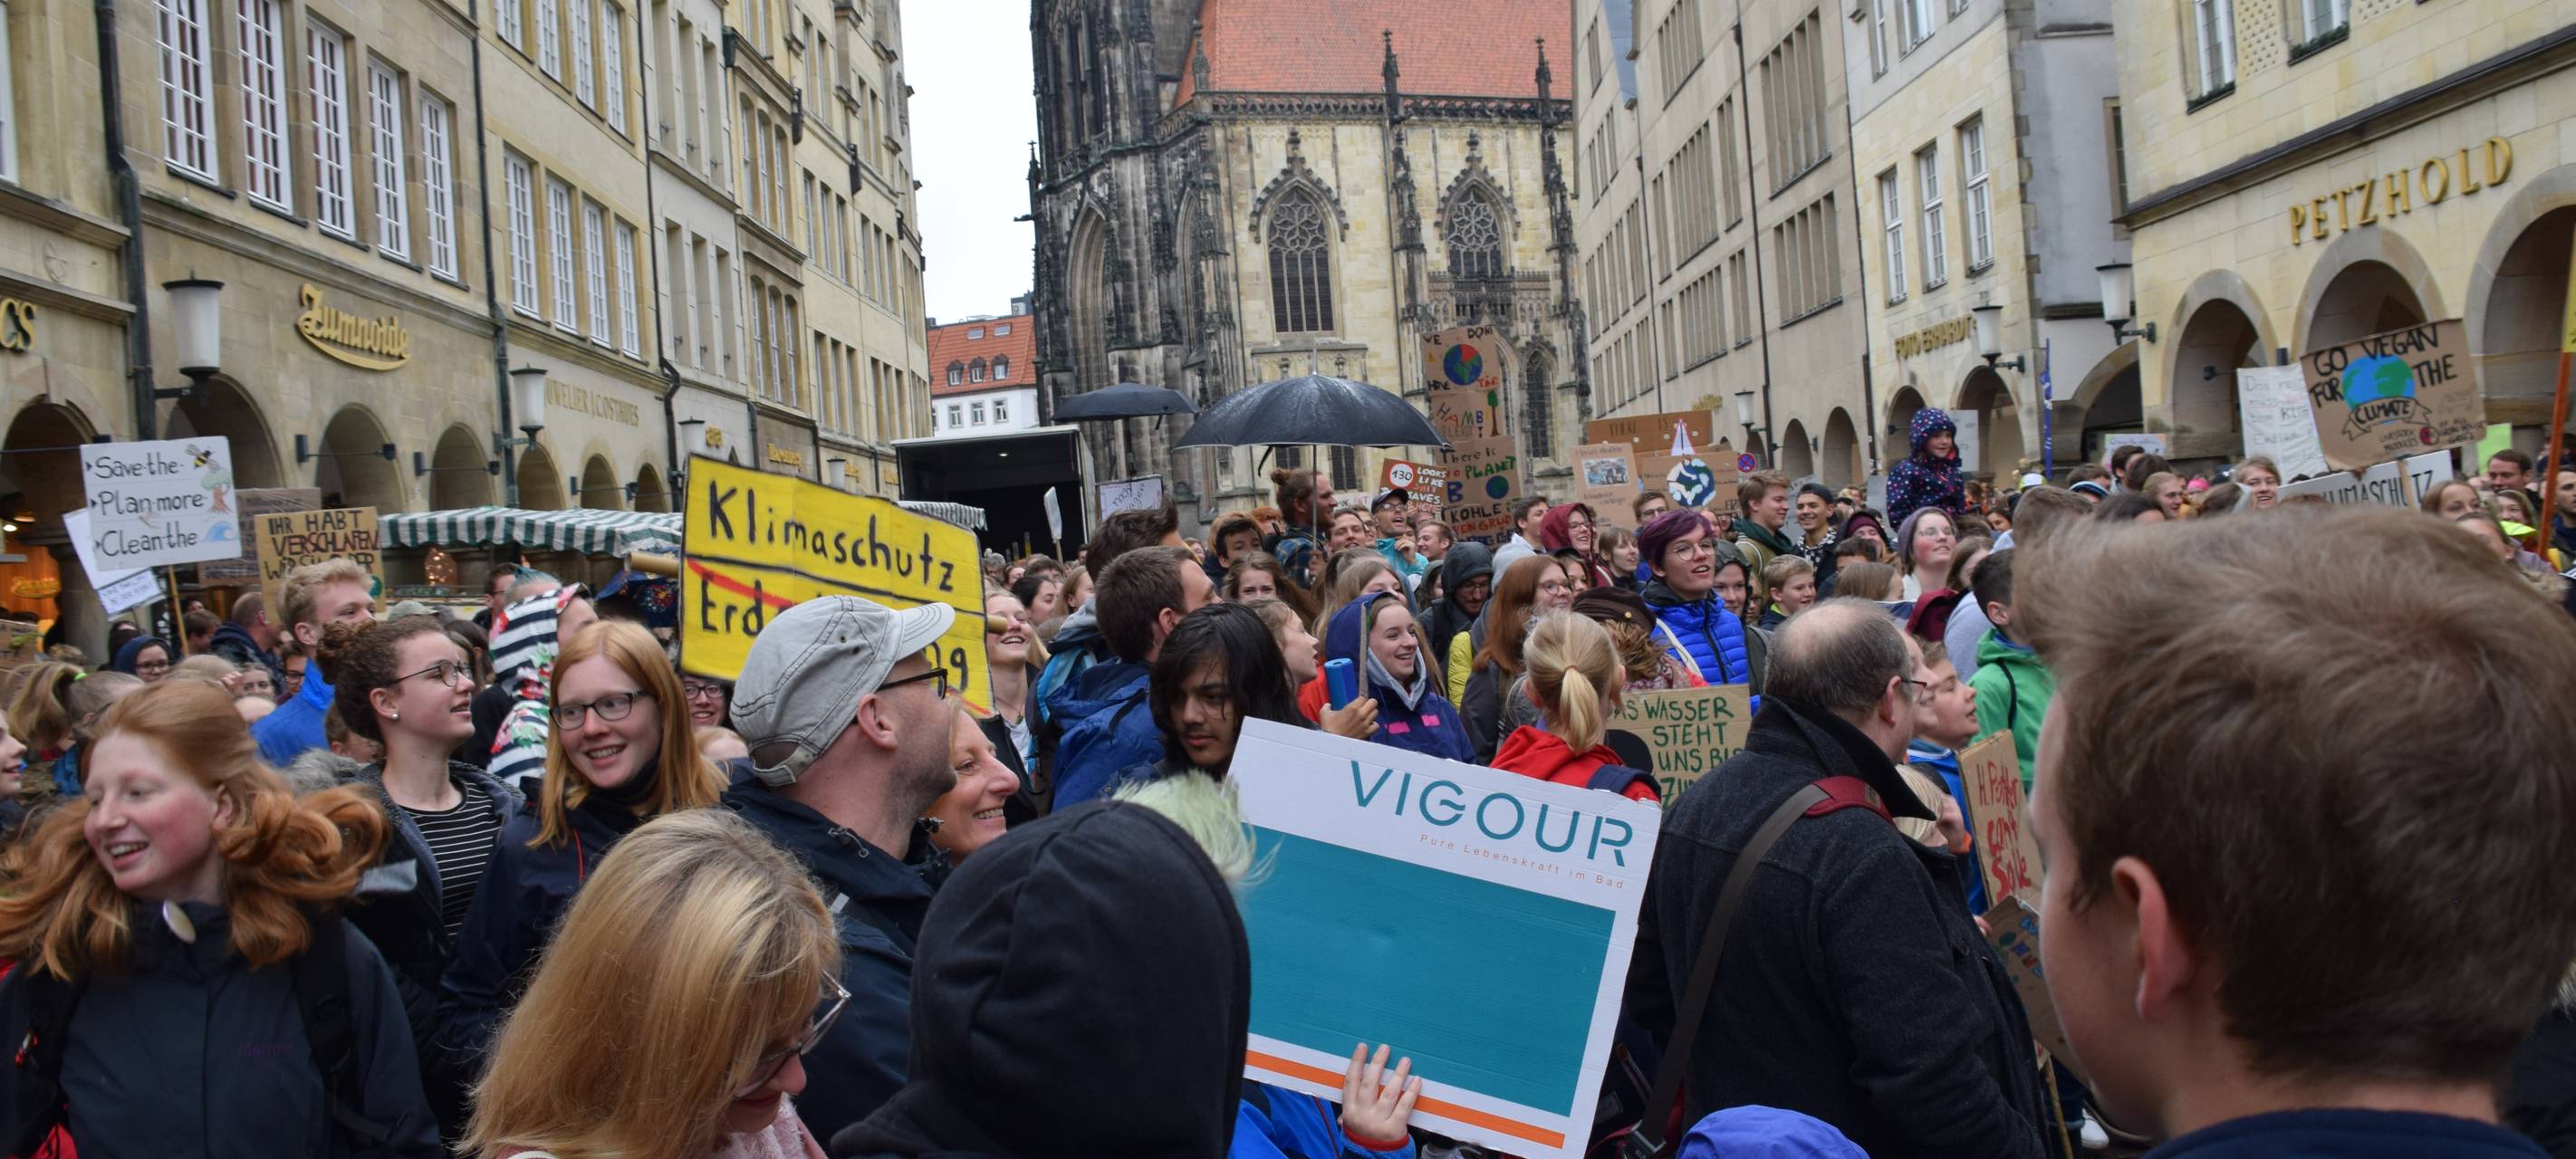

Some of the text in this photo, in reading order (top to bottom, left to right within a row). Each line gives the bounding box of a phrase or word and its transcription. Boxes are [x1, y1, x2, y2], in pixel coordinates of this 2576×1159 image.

[2289, 136, 2514, 246] PETZHOLD
[2313, 323, 2439, 377] GO VEGAN
[2310, 354, 2457, 408] FOR THE
[2355, 399, 2411, 425] CLIMATE
[95, 456, 143, 479] Save
[1440, 448, 1481, 464] There
[1465, 455, 1516, 479] PLANET
[1391, 469, 1413, 482] 130
[1418, 467, 1447, 478] LOOKS
[1419, 477, 1445, 488] LIKE
[157, 493, 204, 512] more
[1447, 481, 1464, 503] B
[268, 510, 362, 535] IHR HABT
[101, 521, 198, 557] Clean the
[709, 480, 956, 594] Klimaschutz
[1644, 695, 1735, 722] WASSER
[1653, 722, 1728, 747] STEHT
[1658, 749, 1704, 773] UNS
[1350, 760, 1633, 867] VIGOUR
[1420, 833, 1624, 889] Pure Lebenskraft im Bad
